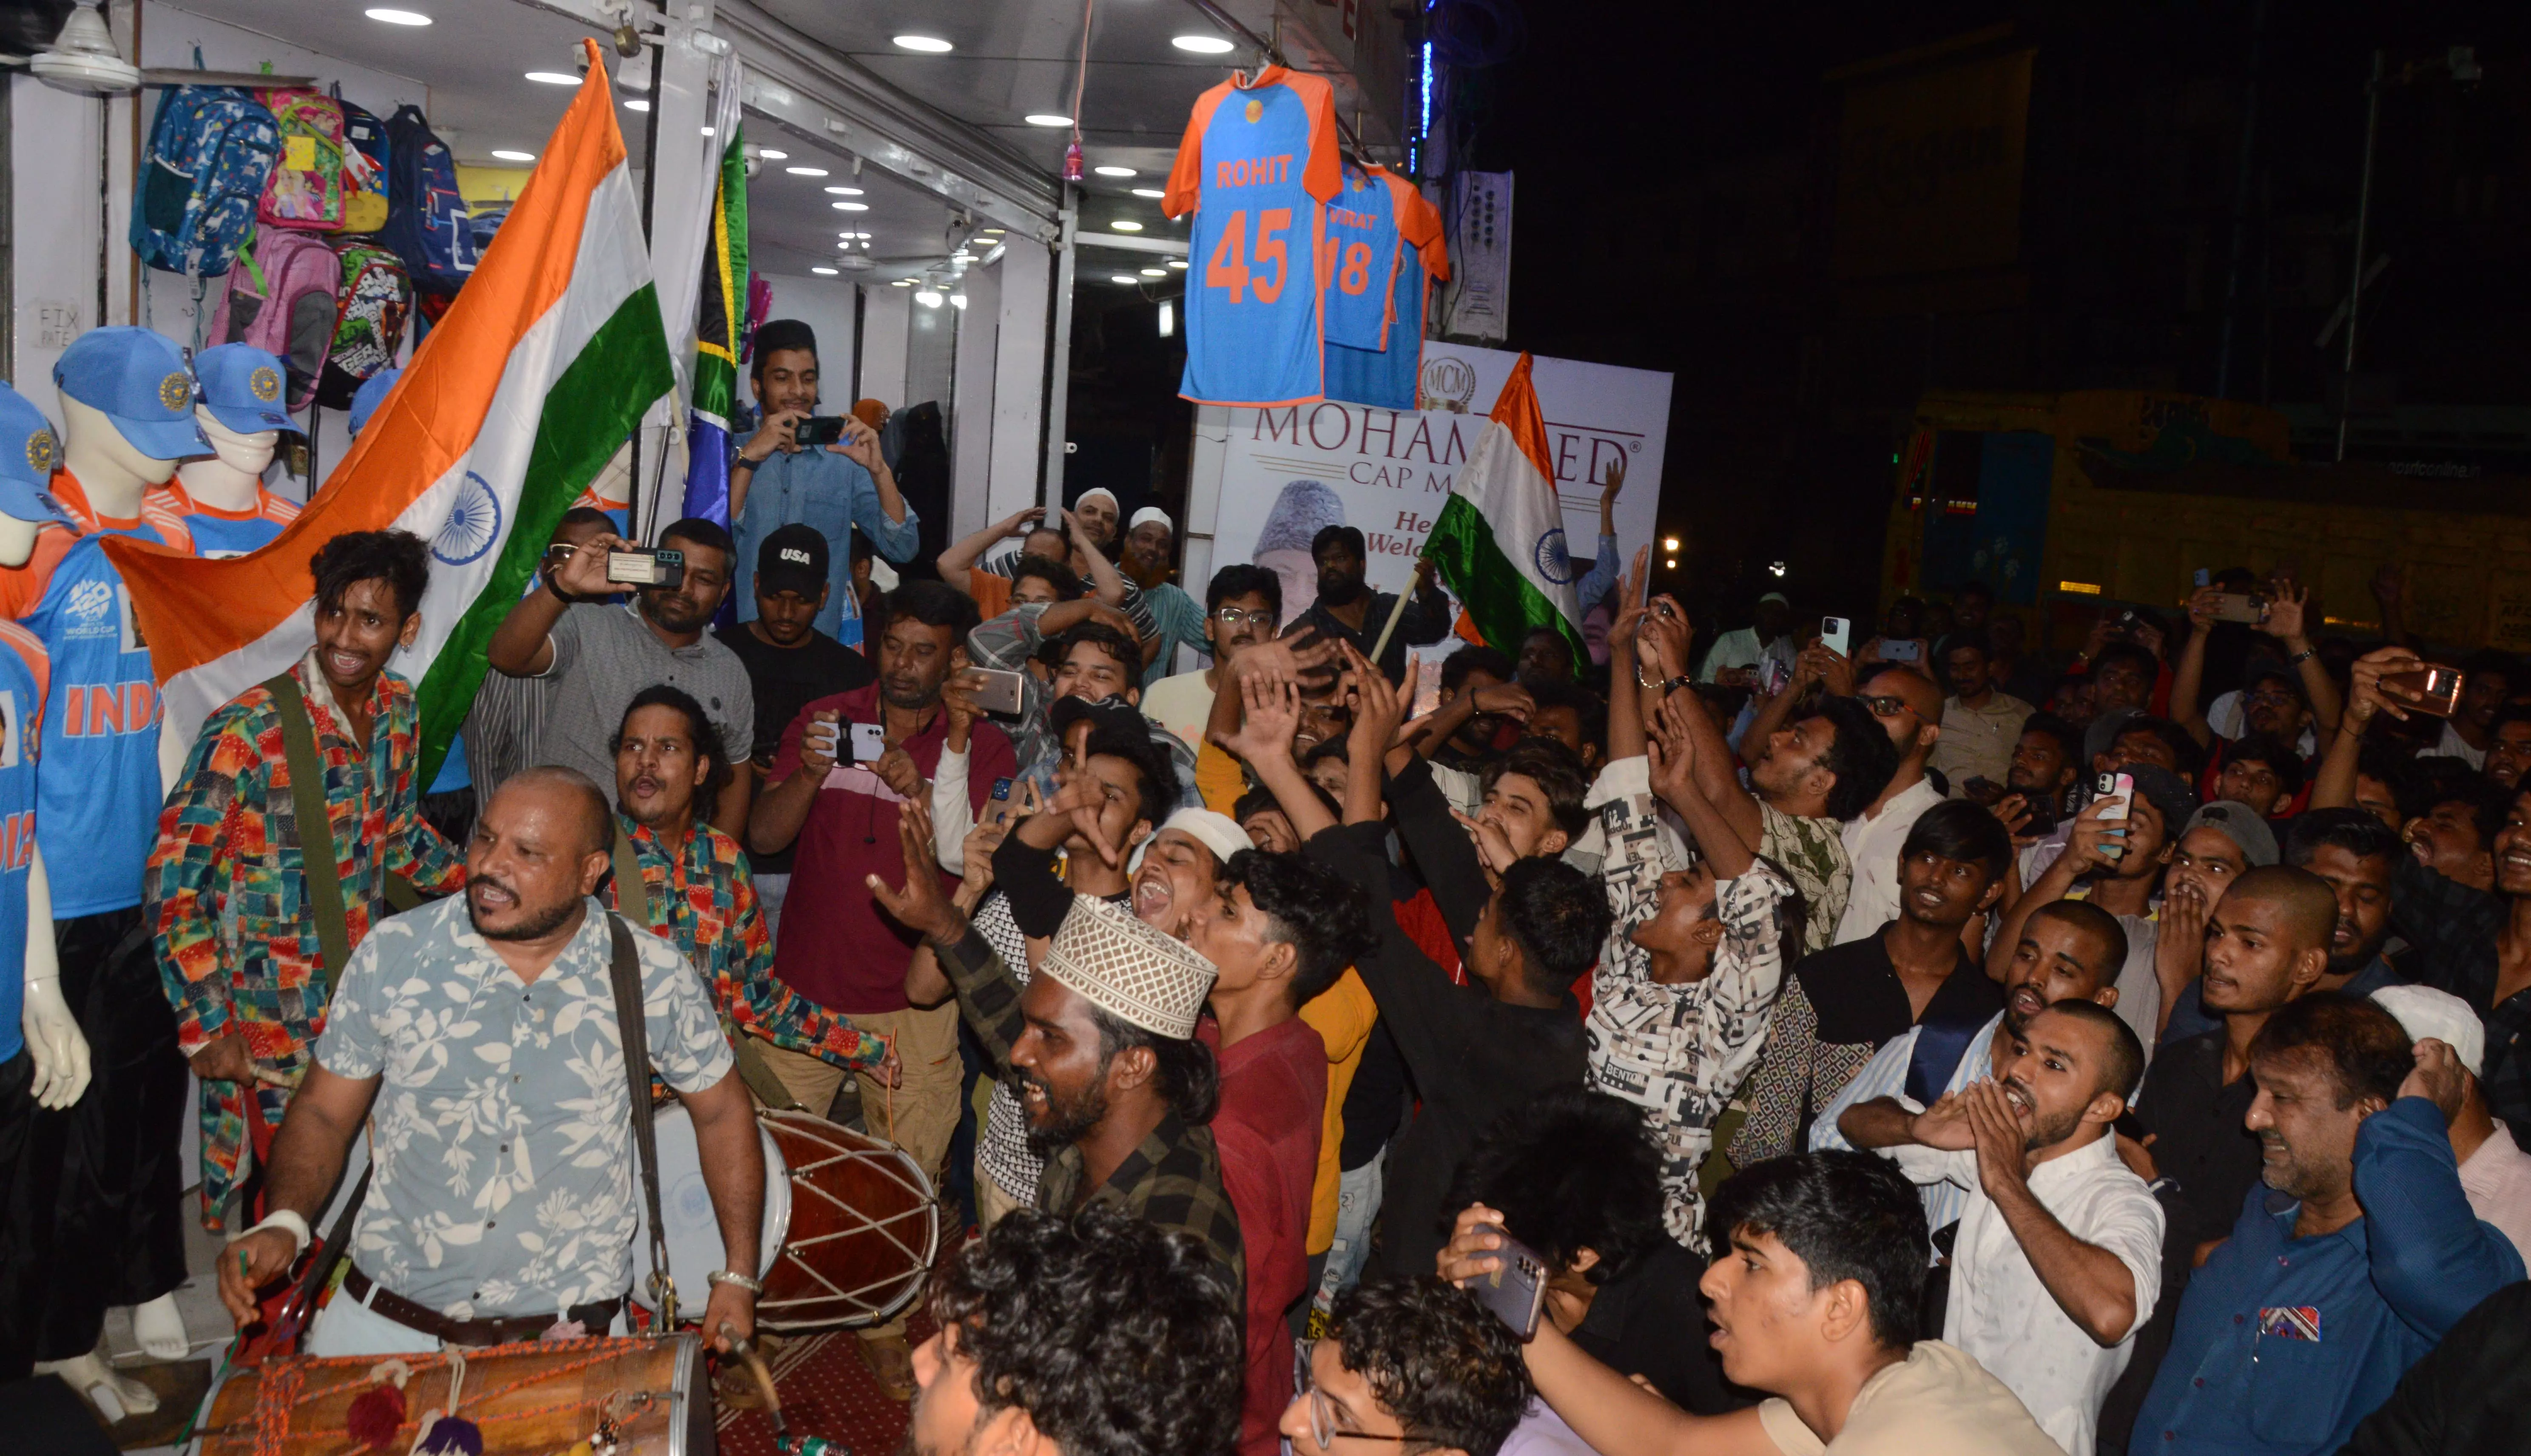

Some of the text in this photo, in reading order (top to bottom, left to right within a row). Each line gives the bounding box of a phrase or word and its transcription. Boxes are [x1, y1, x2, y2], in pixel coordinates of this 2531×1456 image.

[1217, 154, 1293, 188] ROHIT
[1329, 208, 1378, 231] VIRAT
[1206, 208, 1292, 304] 45
[1325, 237, 1373, 296] 18
[41, 309, 78, 329] FIX
[42, 330, 70, 347] RATE
[1429, 364, 1466, 393] MCM
[1251, 403, 1628, 486] MOHAED
[1350, 461, 1413, 489] CAP
[780, 548, 810, 565] USA
[1368, 532, 1425, 558] Welc
[67, 625, 116, 635] WORLD CUP
[1605, 1063, 1645, 1085] BENTON
